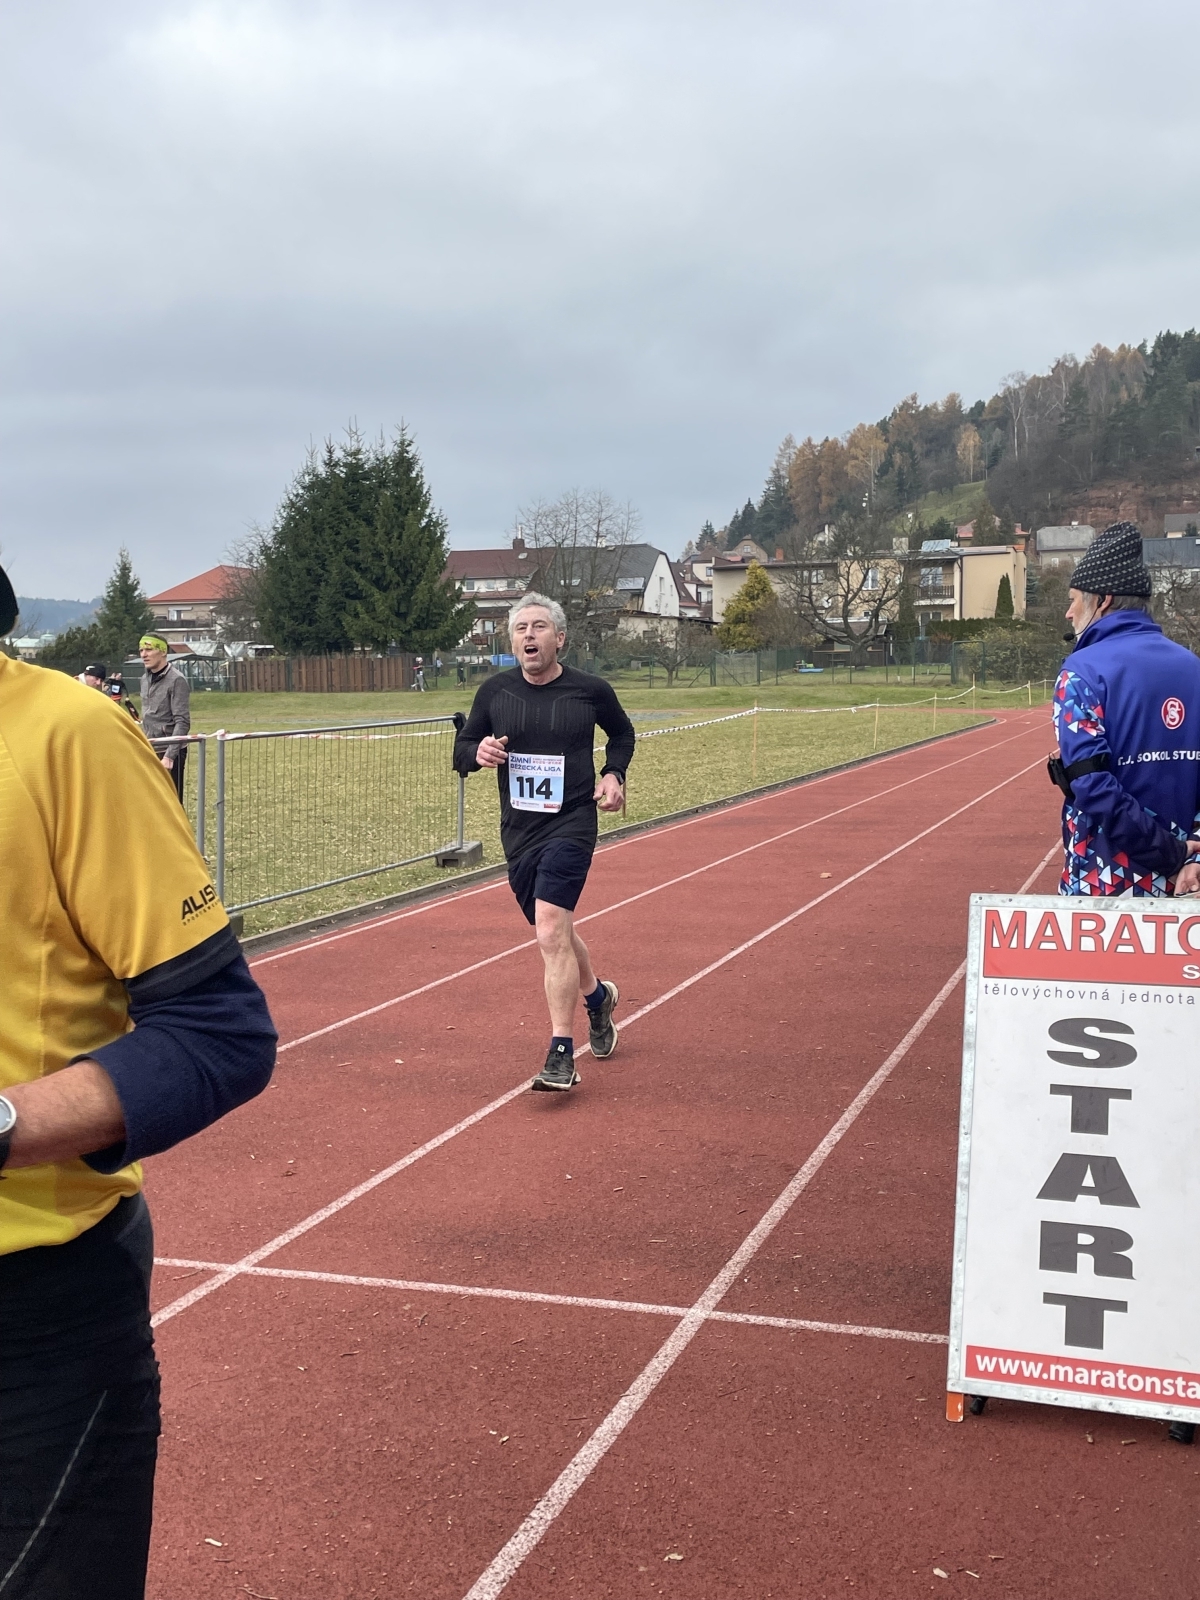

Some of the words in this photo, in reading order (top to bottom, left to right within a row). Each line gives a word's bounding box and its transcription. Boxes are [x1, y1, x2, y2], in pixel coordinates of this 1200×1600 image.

[1137, 751, 1171, 763] SOKOL
[516, 776, 553, 800] 114
[984, 983, 1110, 1001] tělovýchovná
[1120, 988, 1196, 1005] jednota
[1035, 1017, 1141, 1351] START
[975, 1354, 1200, 1400] www.maratonsta
